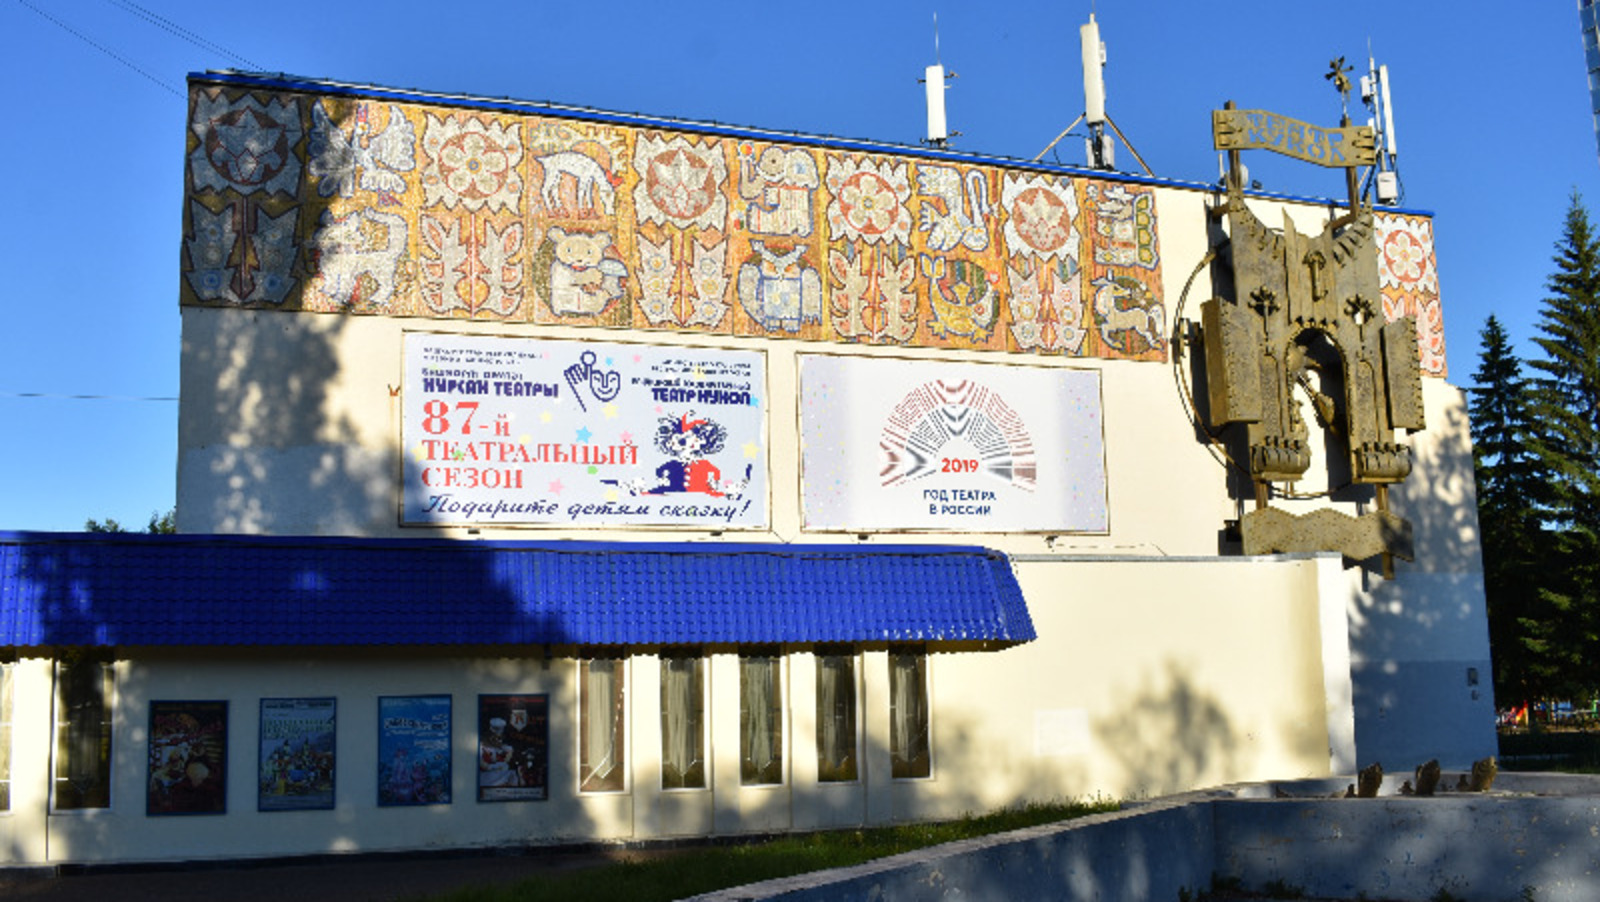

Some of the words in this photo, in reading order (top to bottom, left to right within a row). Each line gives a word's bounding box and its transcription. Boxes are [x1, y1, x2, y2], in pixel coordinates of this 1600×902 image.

[494, 381, 559, 398] ТЕАТРЫ
[651, 388, 697, 403] ТЕАТР
[421, 399, 511, 437] 87-й
[421, 439, 639, 465] ТЕАТРАЛЬНЫЙ
[941, 457, 979, 473] 2019
[421, 467, 523, 489] СЕЗОН
[923, 489, 948, 502] ГОД
[951, 489, 997, 501] ТЕАТРА
[421, 493, 559, 519] Подарите
[567, 502, 650, 520] детям
[659, 499, 752, 522] сказку!
[929, 503, 938, 515] В
[941, 504, 991, 516] РОССИИ
